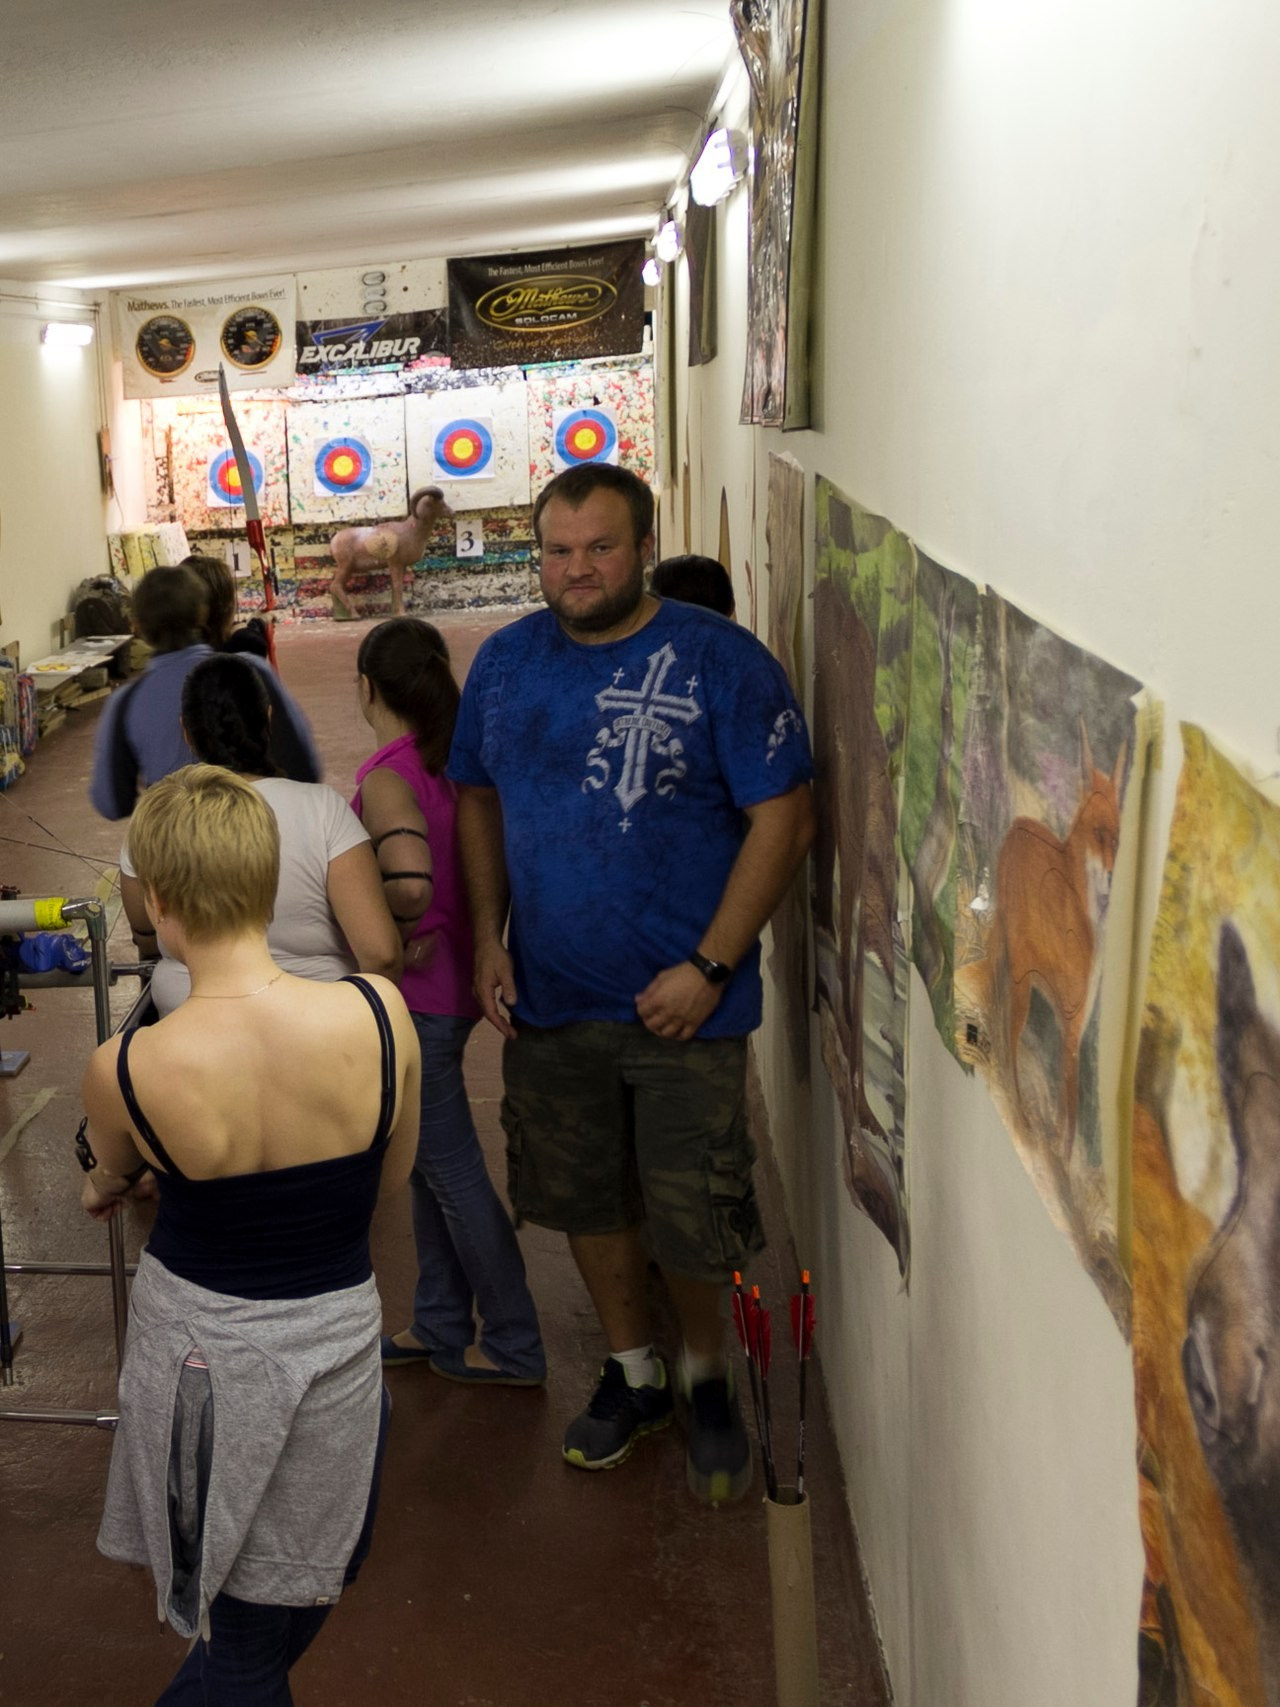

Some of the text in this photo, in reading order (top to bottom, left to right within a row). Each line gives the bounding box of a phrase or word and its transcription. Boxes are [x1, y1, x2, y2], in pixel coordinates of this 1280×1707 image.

[488, 266, 499, 277] The
[524, 263, 541, 274] Most
[542, 260, 569, 272] Efficient
[127, 288, 286, 313] Mathews. The Fastest, Most Efficient Bows Ever!
[515, 312, 578, 325] SOLOCAM
[299, 336, 422, 364] EXCALIBUR
[460, 530, 475, 552] 3
